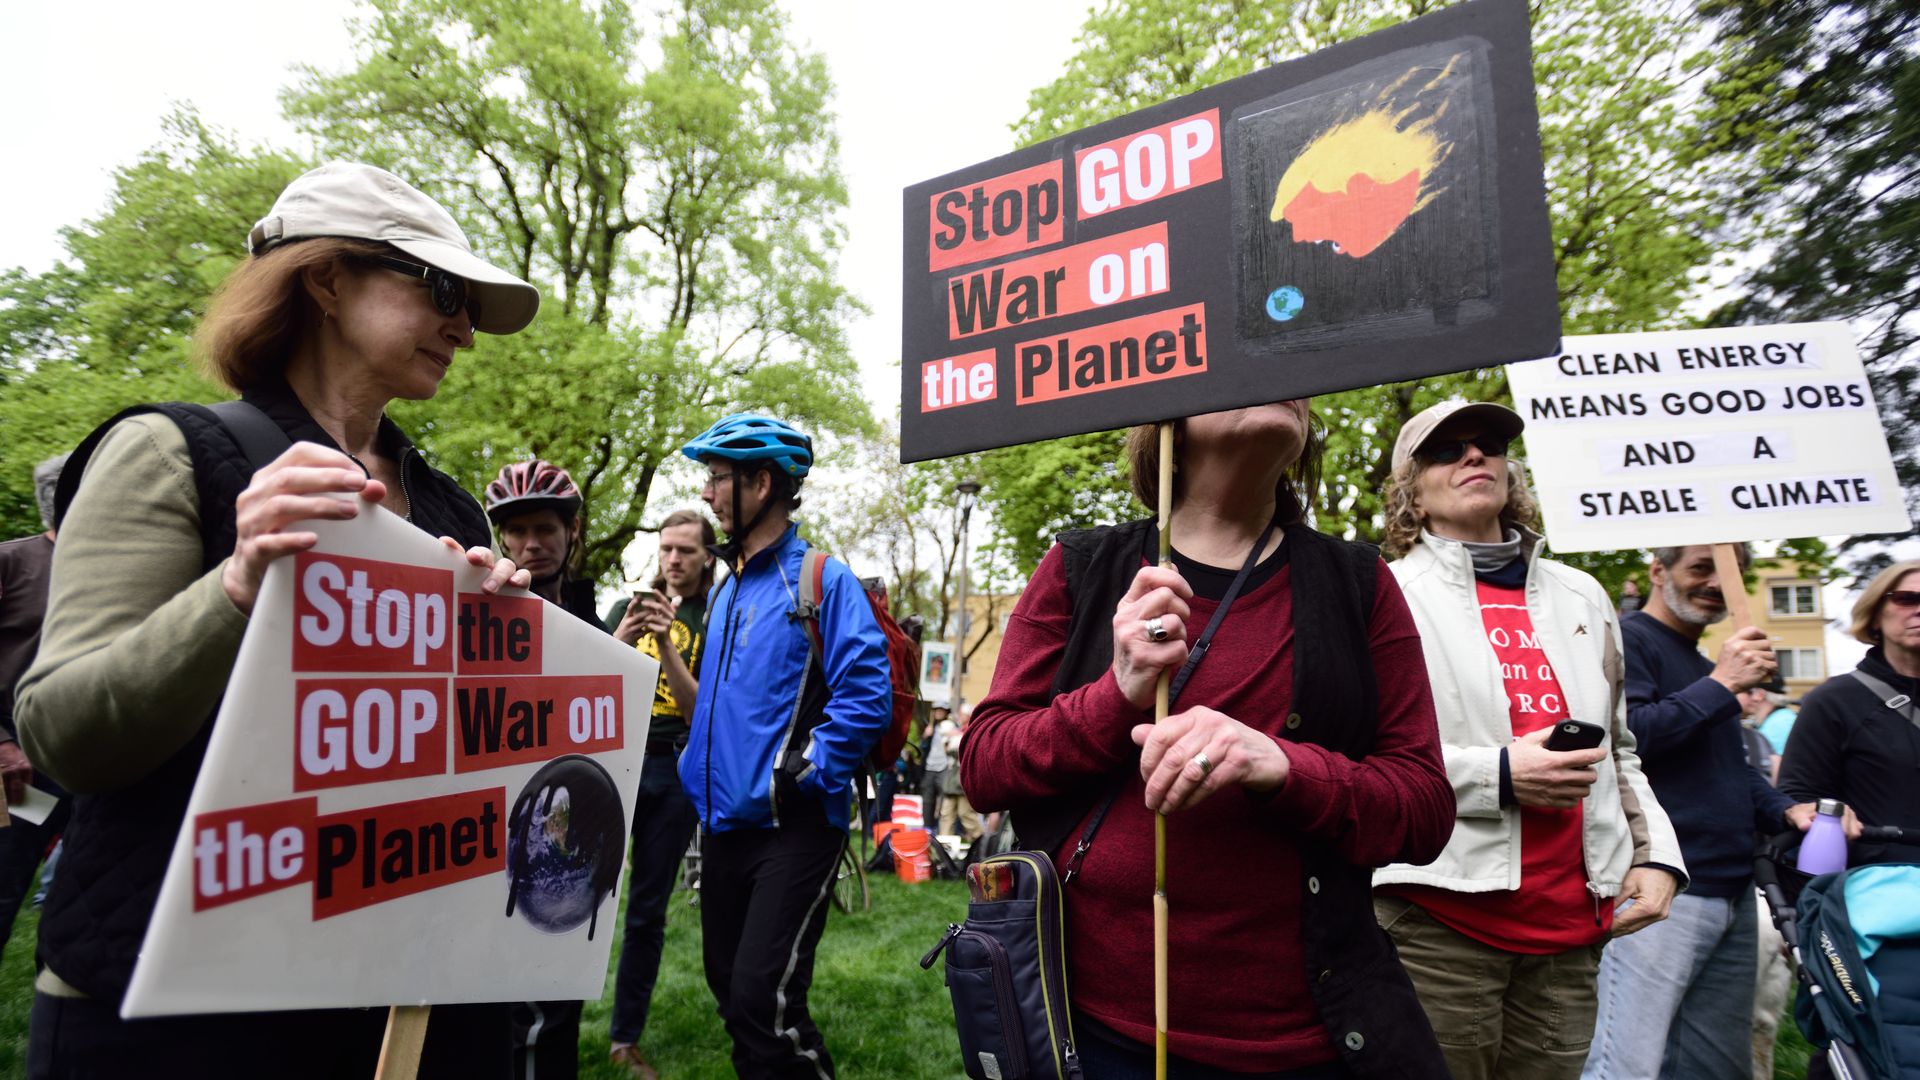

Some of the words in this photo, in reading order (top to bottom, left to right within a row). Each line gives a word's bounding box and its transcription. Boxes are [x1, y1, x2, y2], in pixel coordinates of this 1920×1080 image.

[935, 178, 1059, 250] Stop
[1079, 118, 1214, 214] GOP
[951, 266, 1066, 336] War
[1089, 242, 1166, 305] on
[924, 360, 994, 408] the
[1021, 314, 1203, 398] Planet
[1531, 392, 1647, 420] MEANS
[1662, 389, 1766, 415] GOOD
[1782, 384, 1864, 410] JOBS
[1558, 351, 1660, 377] CLEAN
[1679, 342, 1806, 370] ENERGY
[1623, 440, 1695, 468] AND
[1753, 436, 1776, 459] A
[1580, 488, 1698, 517] STABLE
[1731, 478, 1870, 510] CLIMATE
[300, 561, 446, 665] Stop
[458, 602, 531, 661] the
[1501, 663, 1528, 680] an
[300, 689, 438, 776] GOP
[457, 686, 554, 756] War
[569, 694, 616, 744] on
[195, 821, 305, 898] the
[317, 801, 498, 900] Planet
